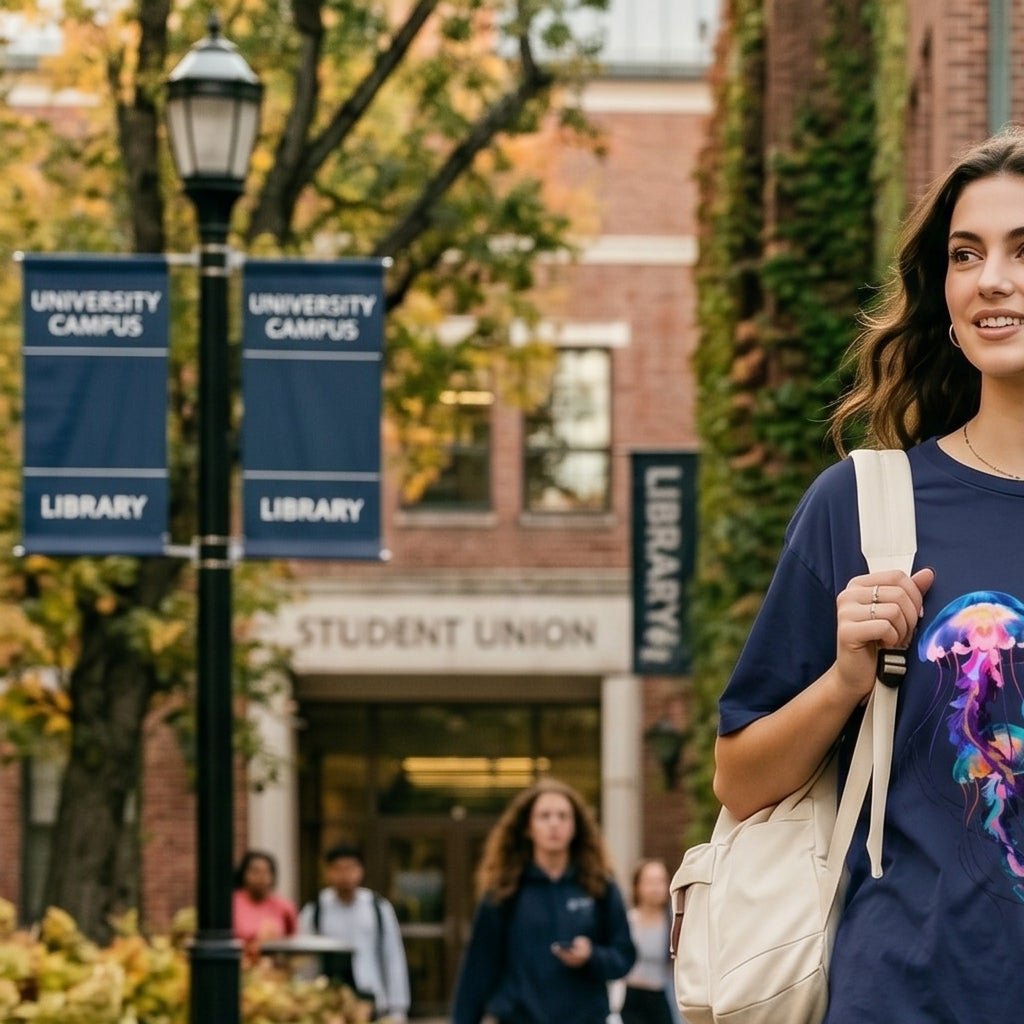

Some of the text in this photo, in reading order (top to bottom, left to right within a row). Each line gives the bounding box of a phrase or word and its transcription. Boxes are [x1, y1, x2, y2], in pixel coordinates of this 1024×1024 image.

[30, 290, 161, 313] UNIVERSITY
[248, 293, 376, 317] UNIVERSITY
[47, 314, 143, 338] CAMPUS
[265, 318, 359, 341] CAMPUS
[40, 495, 148, 520] LIBRARY
[260, 497, 365, 523] LIBRARY
[299, 617, 597, 648] STUDENT UNION
